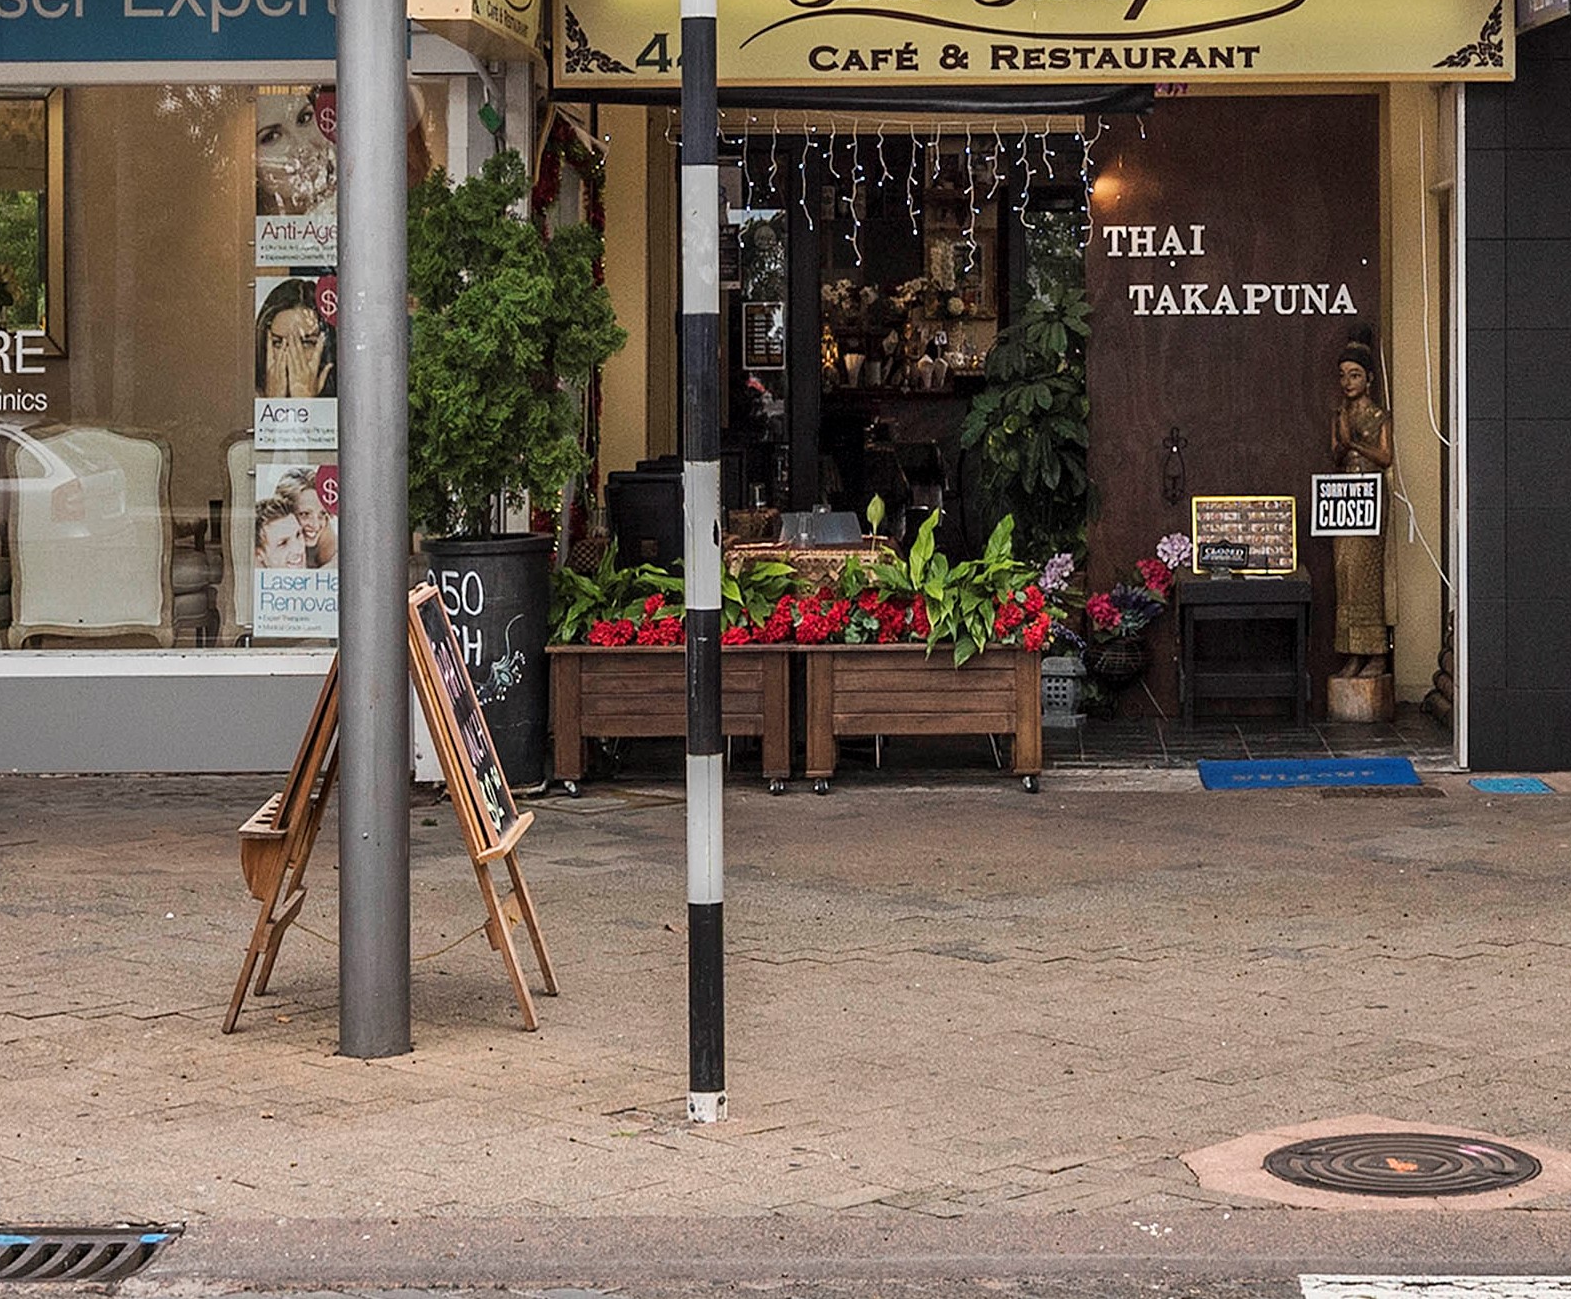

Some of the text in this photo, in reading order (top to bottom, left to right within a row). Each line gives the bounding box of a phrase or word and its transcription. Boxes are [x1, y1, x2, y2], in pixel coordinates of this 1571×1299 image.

[635, 32, 1260, 73] 4 CAFÉ & RESTAURANT
[1102, 224, 1205, 257] THAI
[1129, 283, 1357, 316] TAKAPUNA
[260, 403, 309, 423] Acne
[1319, 482, 1348, 498] SORRY
[1319, 499, 1375, 527] CLOSED
[260, 571, 339, 591] Laser Ha
[260, 591, 338, 612] Remova
